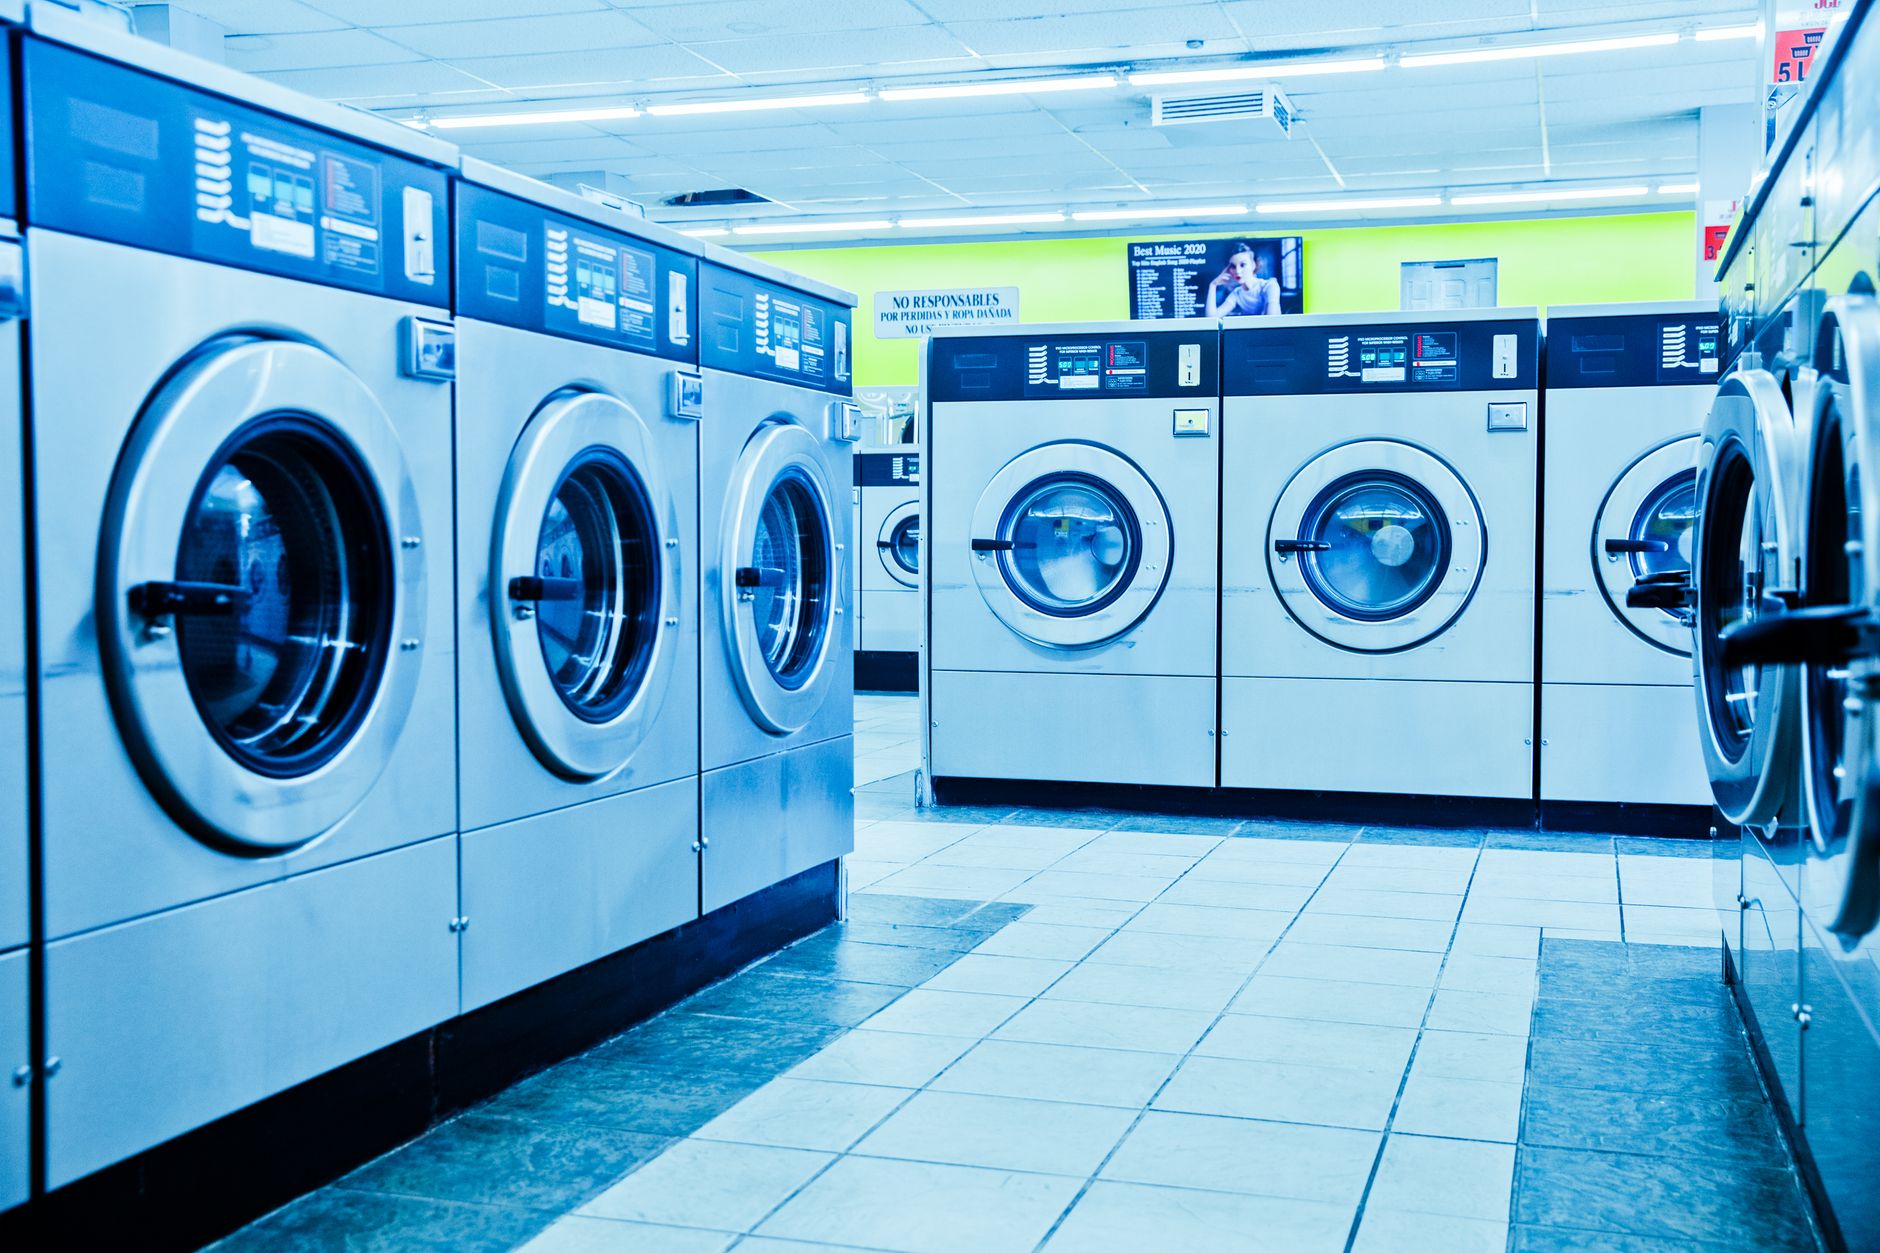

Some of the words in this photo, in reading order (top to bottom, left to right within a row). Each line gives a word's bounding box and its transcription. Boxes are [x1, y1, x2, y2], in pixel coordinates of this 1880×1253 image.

[1134, 246, 1153, 256] Best
[1155, 245, 1182, 256] Music
[1184, 243, 1206, 255] 2020
[893, 296, 909, 309] NO
[913, 293, 999, 309] RESPONSABLES
[881, 312, 898, 321] POR
[900, 311, 942, 321] PERDIDAS
[943, 311, 950, 320] Y
[952, 310, 974, 319] ROPA
[977, 307, 1012, 318] DAÑADA
[905, 325, 918, 334] NO
